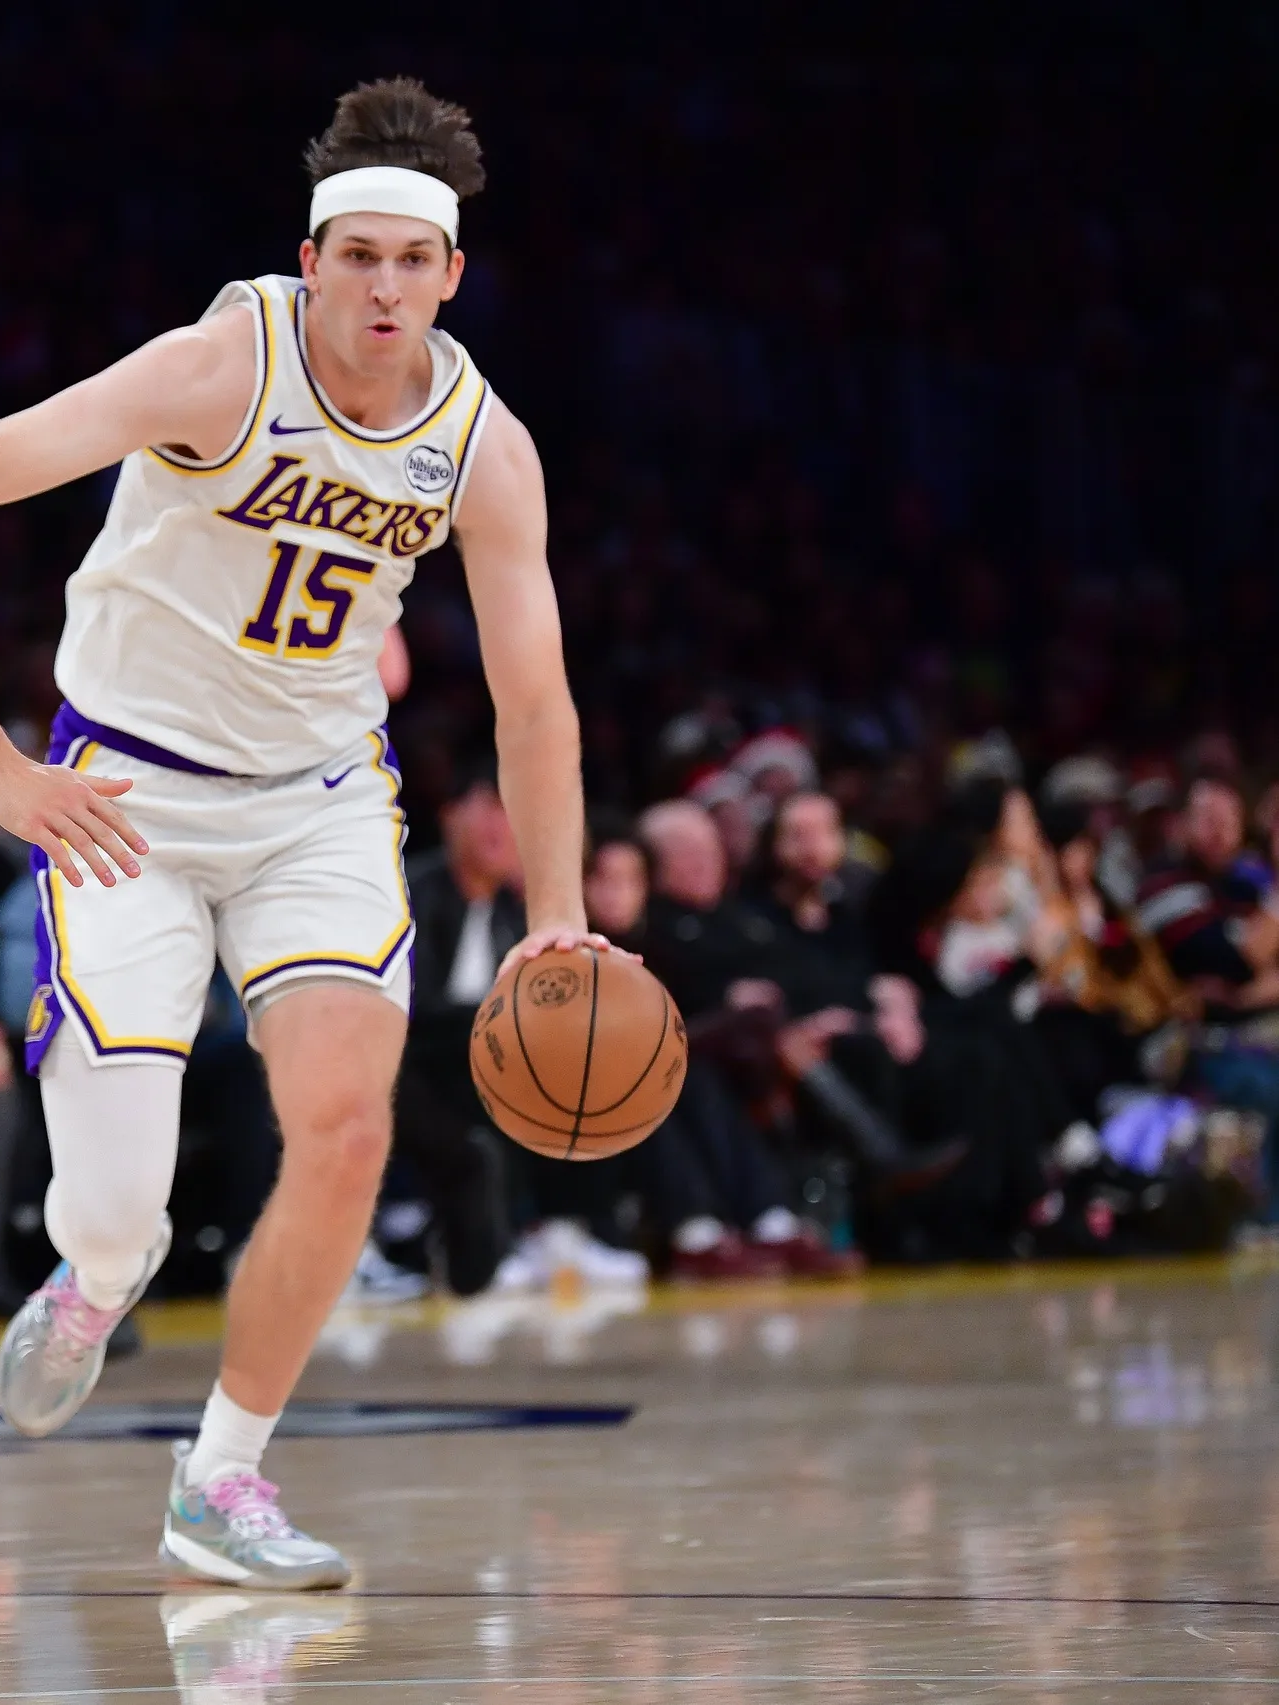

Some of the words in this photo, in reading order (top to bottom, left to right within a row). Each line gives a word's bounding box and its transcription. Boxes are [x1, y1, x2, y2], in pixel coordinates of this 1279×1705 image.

[212, 453, 452, 558] LAKERS
[408, 455, 449, 481] bibigo
[237, 539, 376, 660] 15
